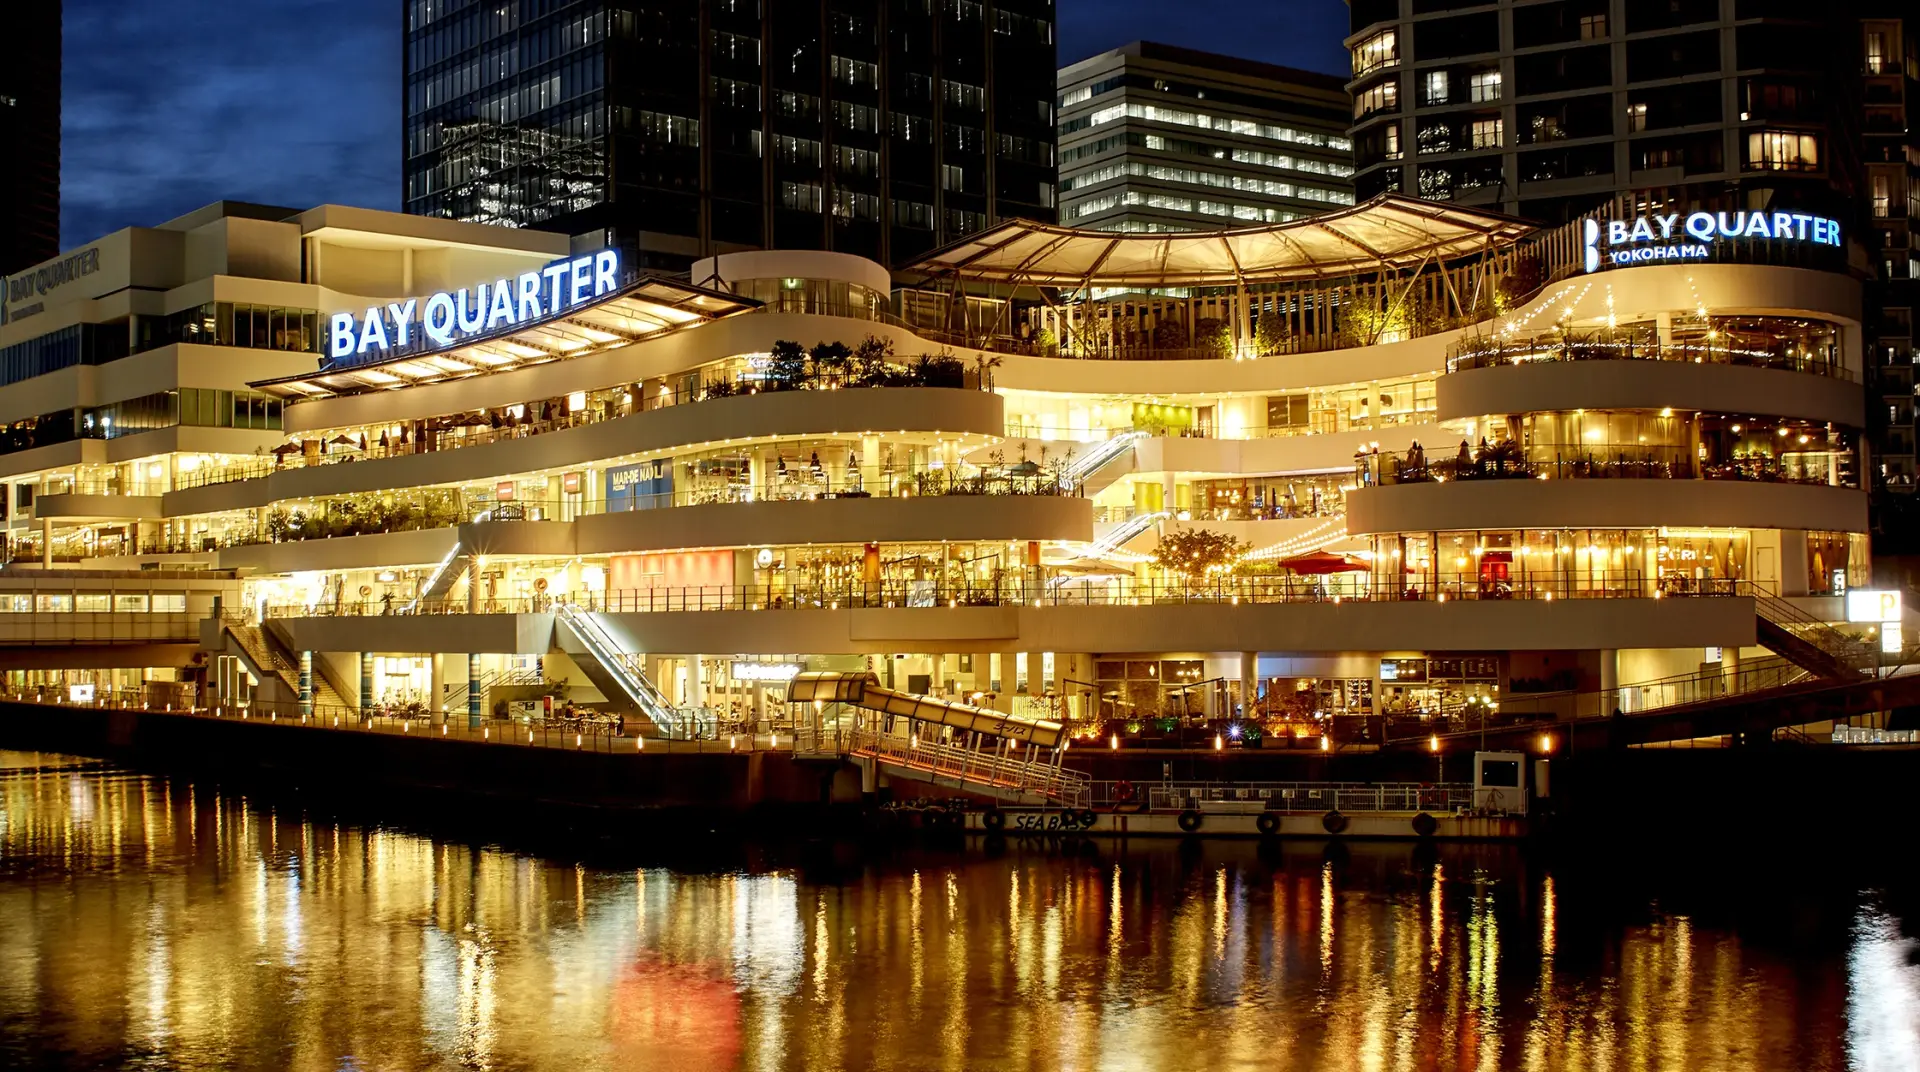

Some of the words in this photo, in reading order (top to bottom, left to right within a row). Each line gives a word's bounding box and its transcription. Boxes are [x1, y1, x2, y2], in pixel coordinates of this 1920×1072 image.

[1609, 213, 1679, 245] BAY
[1686, 211, 1841, 247] QUARTER
[1610, 244, 1708, 264] YOKOHAMA
[10, 272, 36, 303] BAY
[36, 247, 99, 296] QUARTER
[331, 299, 416, 358] BAY
[423, 250, 619, 347] QUARTER
[1880, 593, 1896, 619] P
[1015, 815, 1044, 831] SEA
